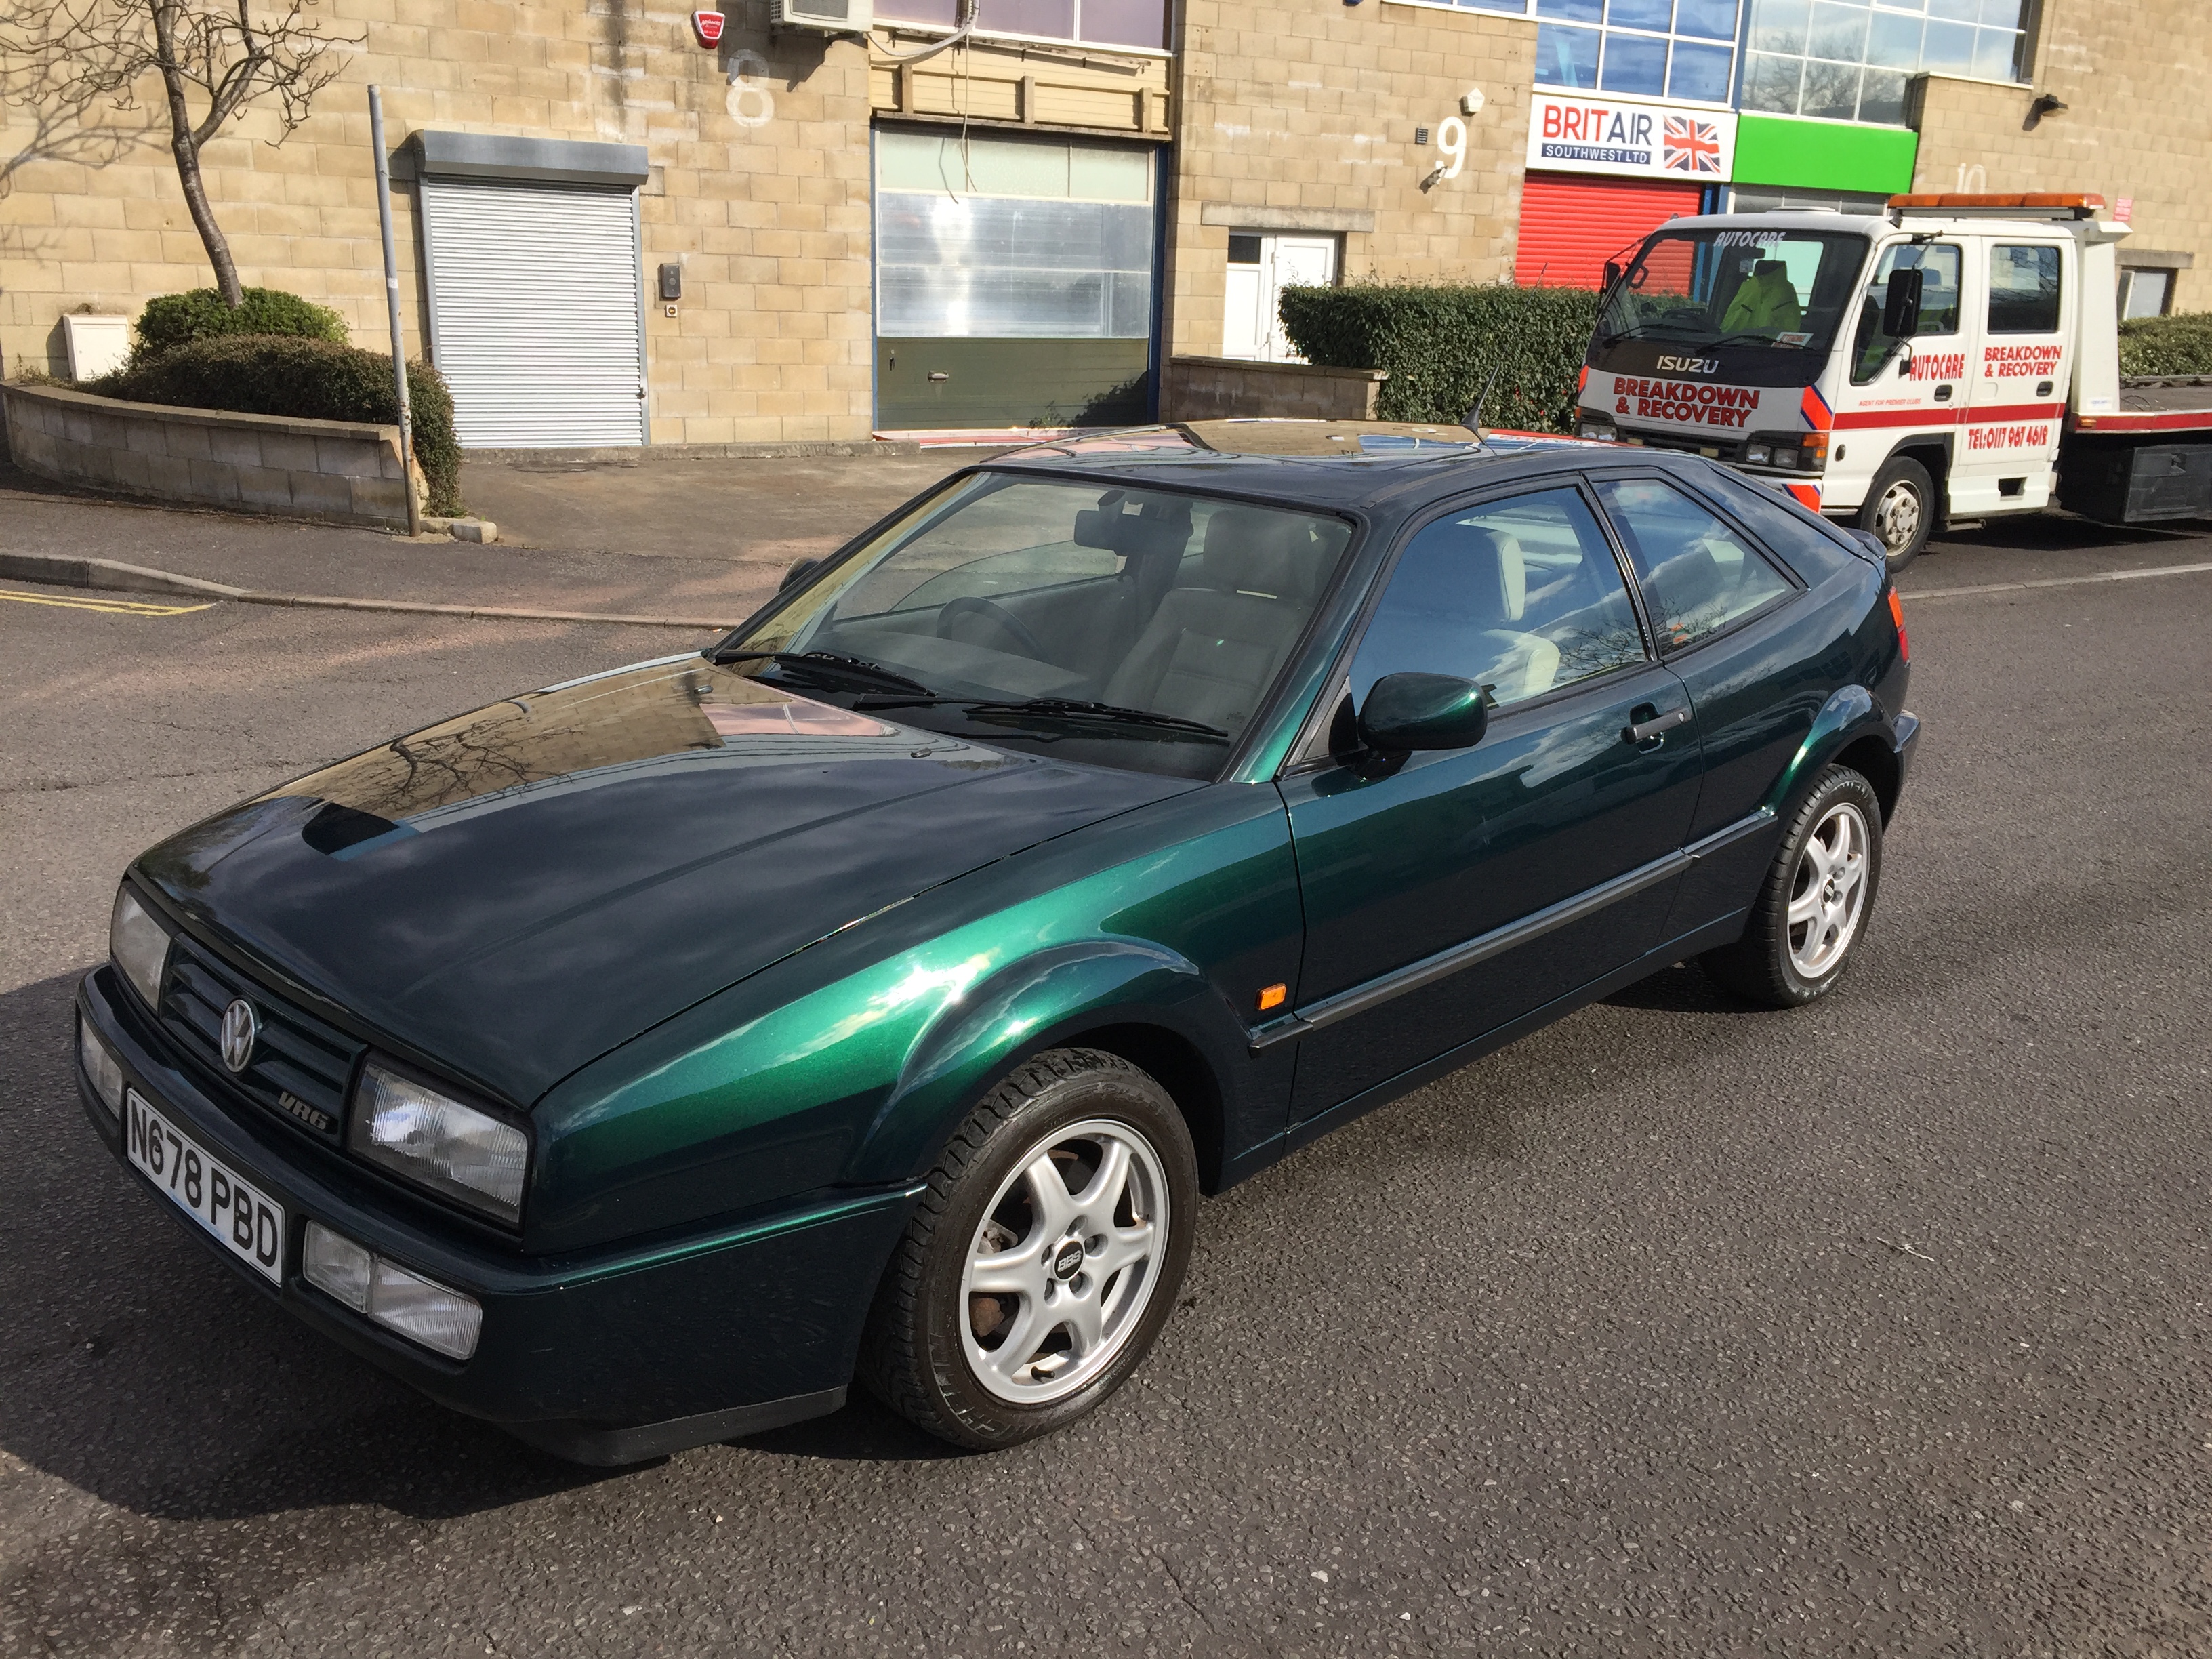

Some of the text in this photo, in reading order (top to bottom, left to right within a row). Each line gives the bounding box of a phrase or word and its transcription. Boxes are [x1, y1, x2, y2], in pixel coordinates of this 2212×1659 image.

[726, 49, 775, 127] 8
[1542, 104, 1652, 146] BRITAIR
[1435, 116, 1467, 179] 9
[1546, 144, 1648, 163] SOUTHWEST LTD
[1713, 231, 1787, 247] AUTOCARE
[1657, 355, 1719, 374] ISUZU
[1909, 354, 1965, 381] AUTOCARE
[1984, 346, 2062, 362] BREAKDOWN
[1984, 361, 2057, 377] & RECOVERY
[1614, 377, 1761, 409] BREAKDOWN
[1616, 396, 1752, 428] & RECOVERY
[2008, 426, 2026, 447] 967
[278, 1091, 328, 1130] VR6
[131, 1099, 202, 1210] N678
[211, 1166, 279, 1268] PBD
[1057, 1250, 1082, 1271] BBS
